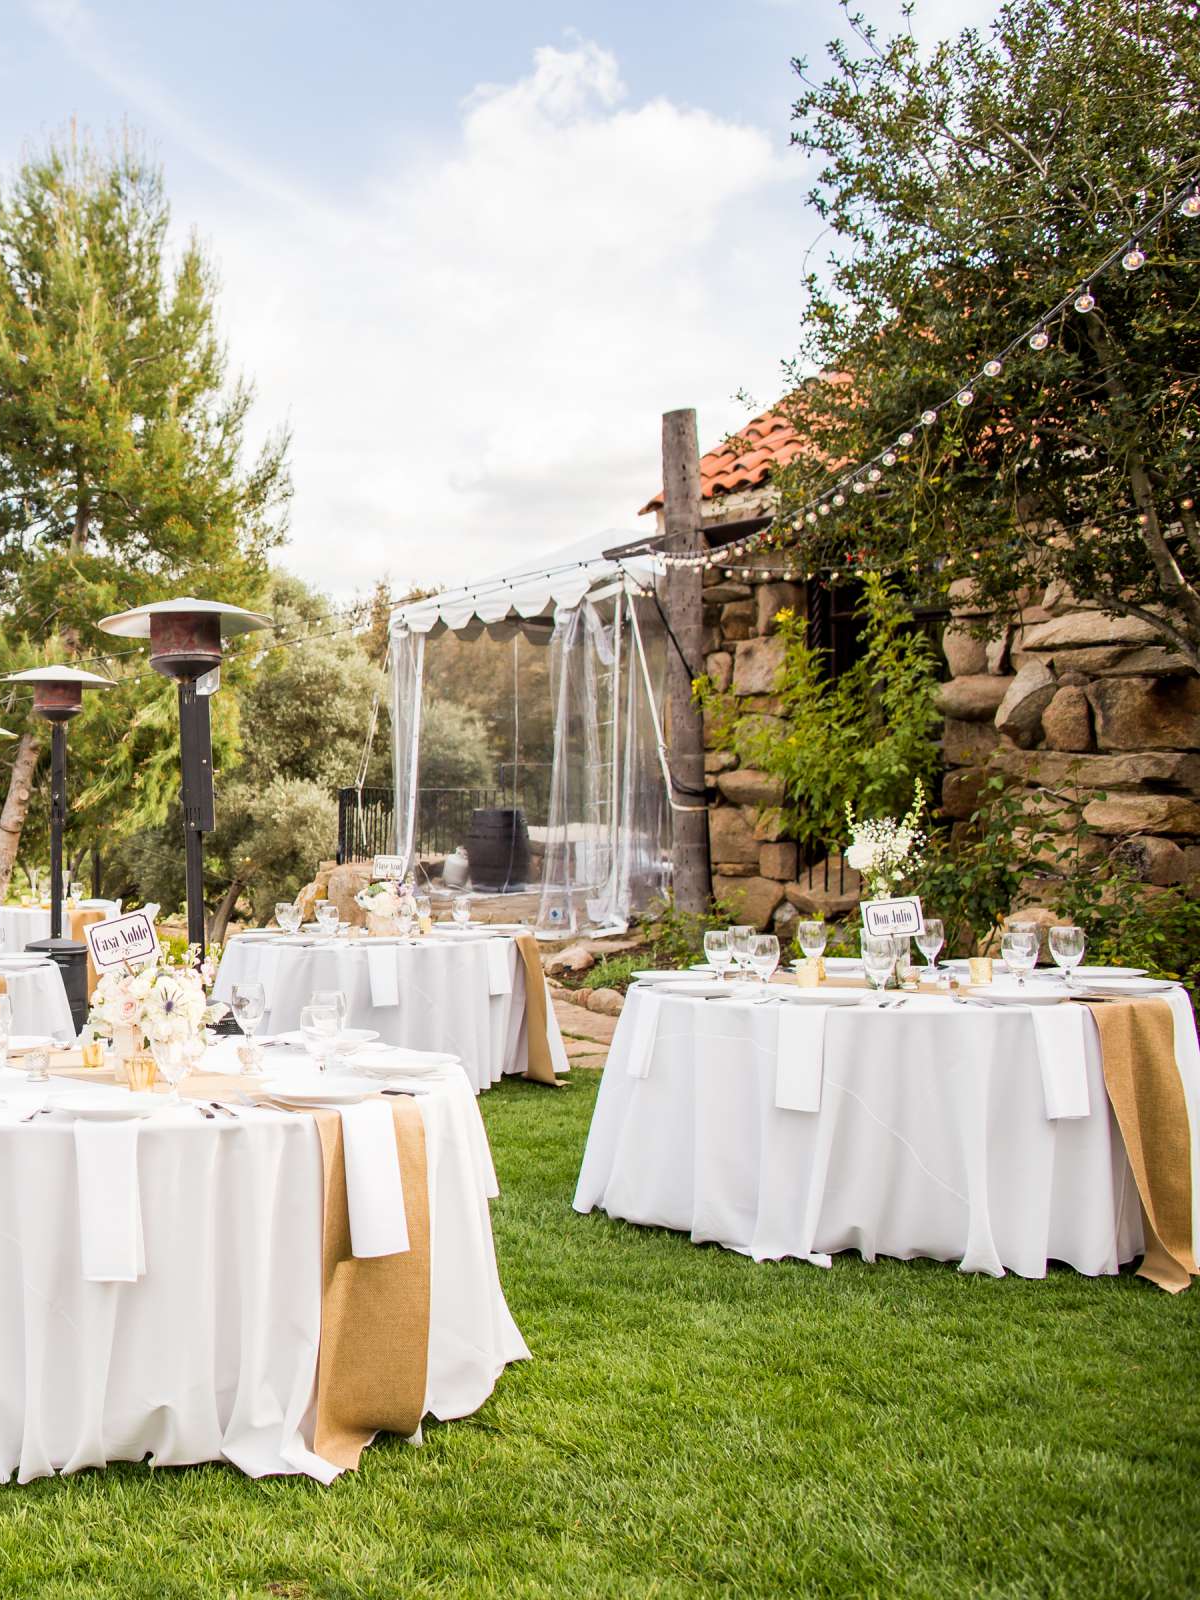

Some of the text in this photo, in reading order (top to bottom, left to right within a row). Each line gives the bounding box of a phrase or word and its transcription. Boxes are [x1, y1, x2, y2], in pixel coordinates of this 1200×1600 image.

[873, 908, 912, 926] Don Julio
[95, 924, 148, 952] Casa Noble
